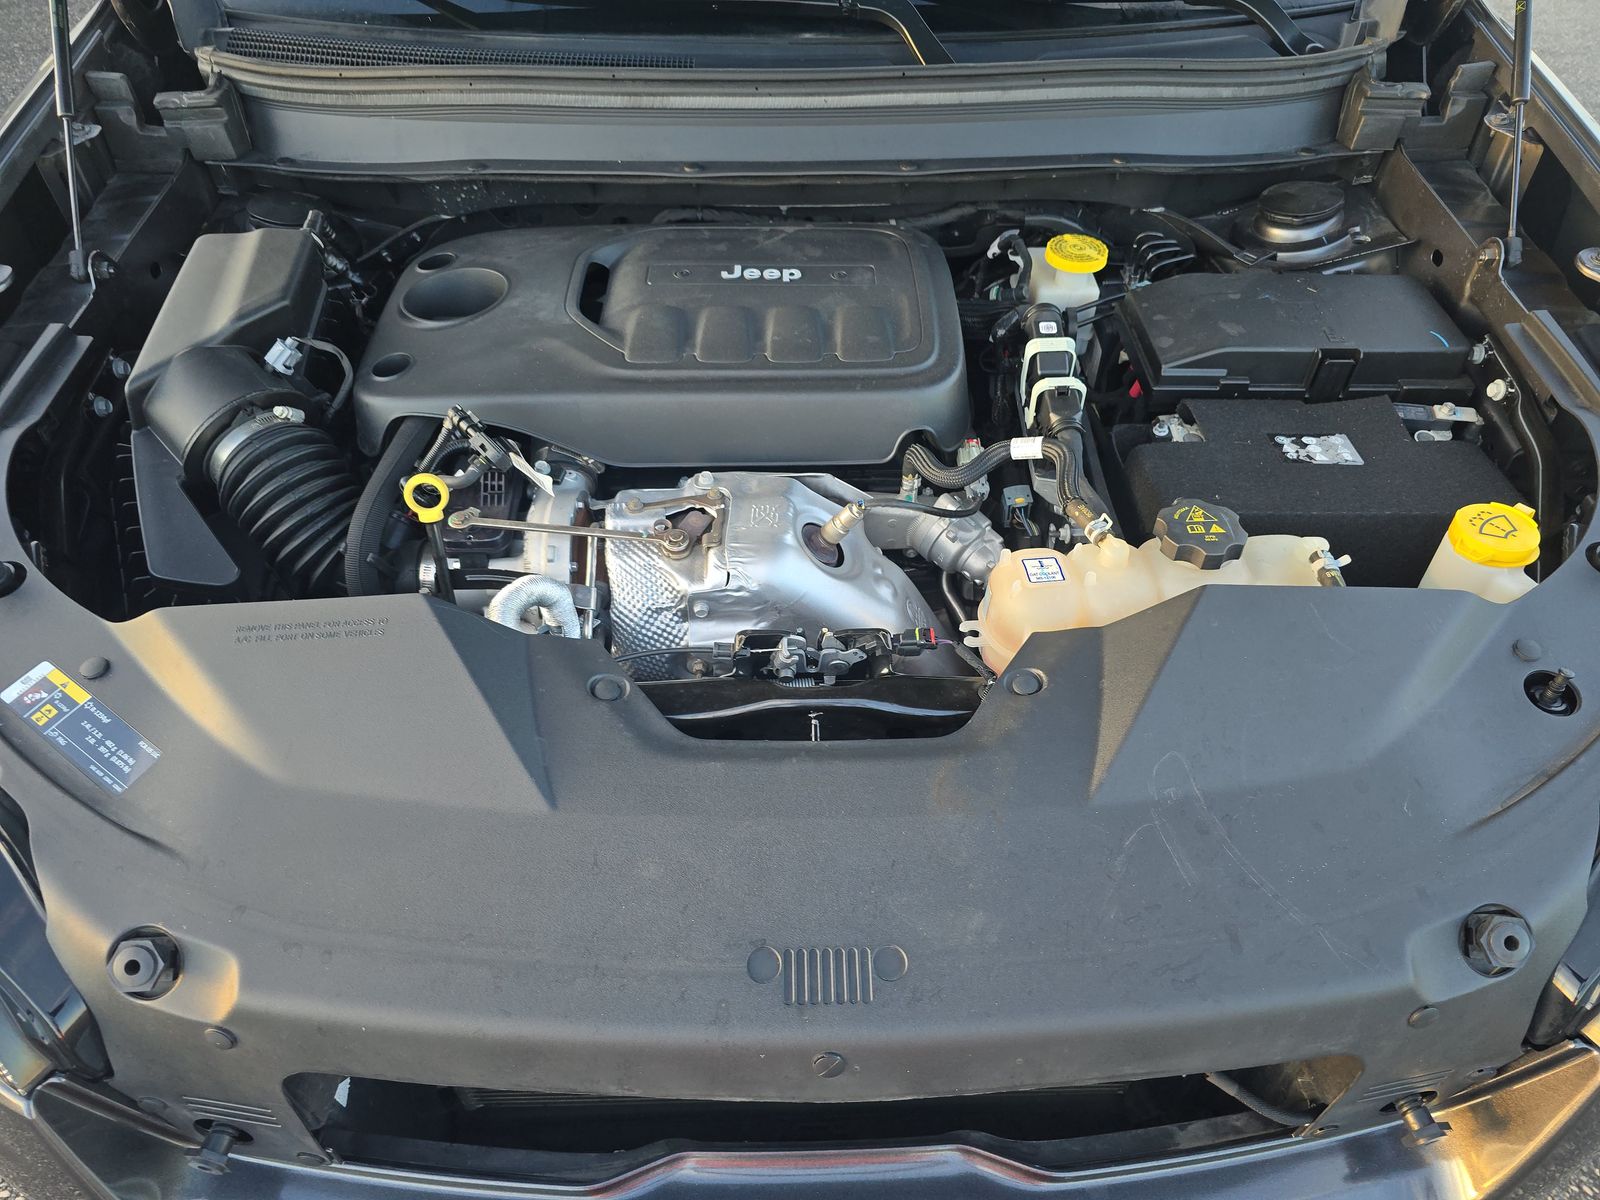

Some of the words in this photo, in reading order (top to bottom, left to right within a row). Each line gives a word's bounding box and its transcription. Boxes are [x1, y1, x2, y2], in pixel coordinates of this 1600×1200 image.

[721, 265, 801, 282] Jeep
[235, 624, 271, 633] REMOVE
[273, 623, 292, 631] THIS
[293, 622, 320, 630] PANEL
[323, 620, 341, 629] FOR
[341, 618, 375, 628] ACCESS
[274, 633, 297, 641] PORT
[300, 632, 314, 640] ON
[315, 631, 340, 639] SOME
[344, 628, 384, 638] VEHICLES
